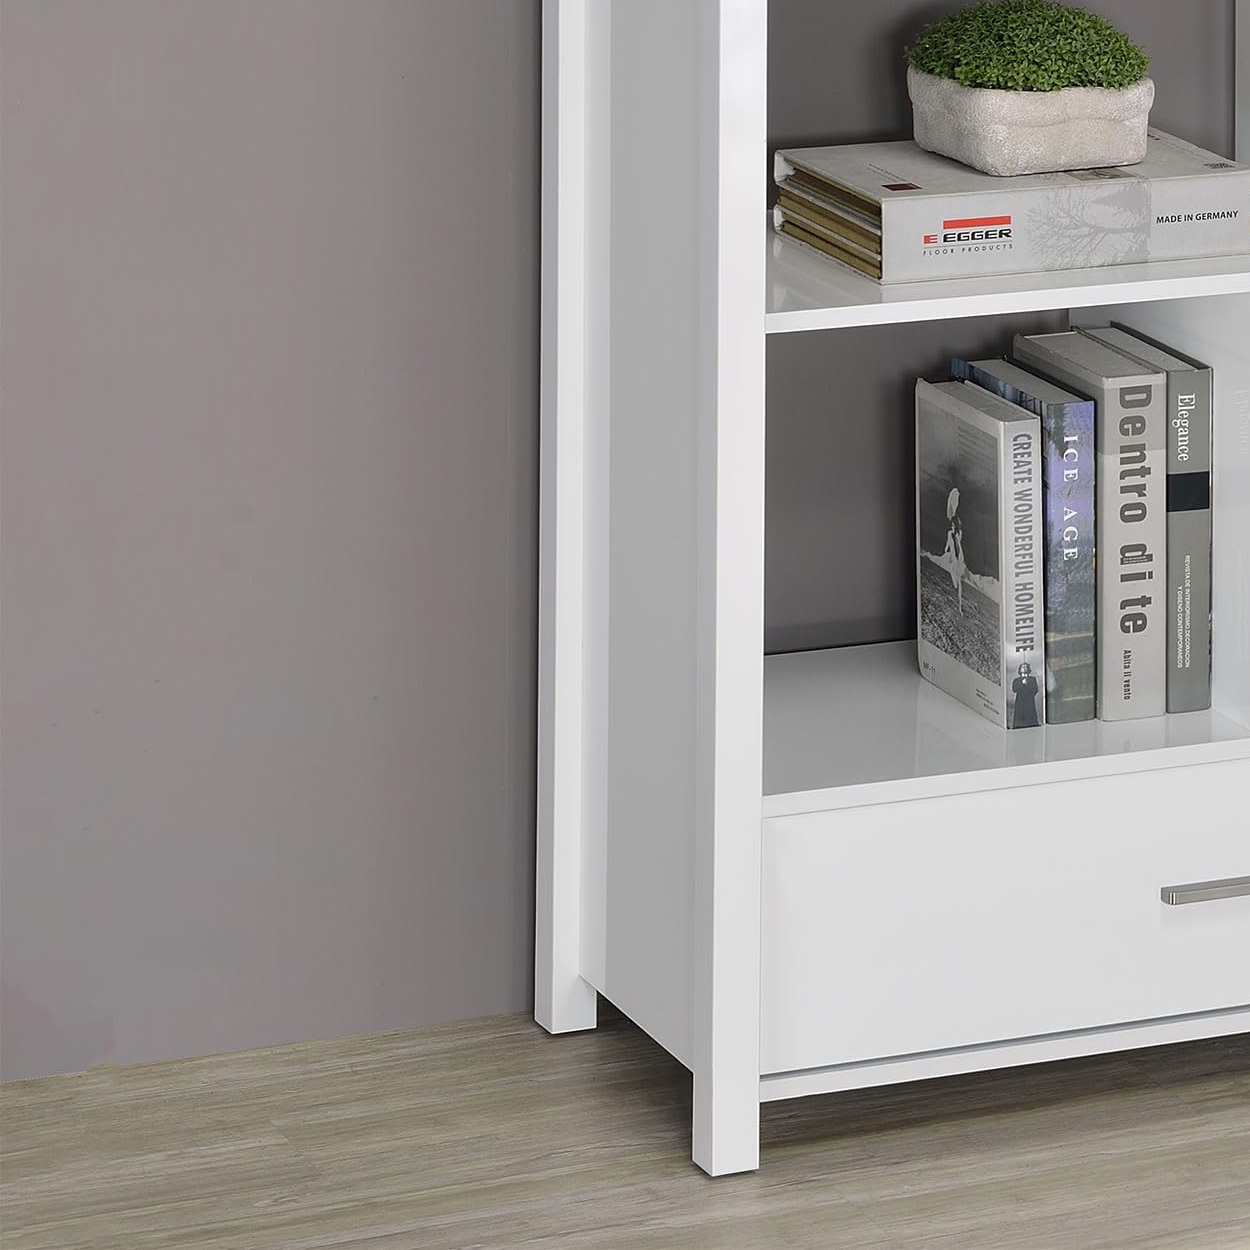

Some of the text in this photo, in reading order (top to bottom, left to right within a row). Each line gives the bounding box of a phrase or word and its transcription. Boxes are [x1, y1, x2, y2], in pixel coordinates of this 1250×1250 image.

[943, 228, 1012, 243] EGGER
[1156, 210, 1239, 224] MADE IN GERMANY
[923, 244, 1013, 256] FLOOR PRODUCTS
[1171, 393, 1196, 462] Elegance
[1063, 435, 1079, 482] ICE
[1119, 384, 1153, 524] Dentro
[1012, 433, 1035, 653] CREATE WONDERFUL HOMELIFE
[1063, 507, 1079, 561] AGE
[1119, 543, 1154, 583] di
[1119, 595, 1153, 634] te
